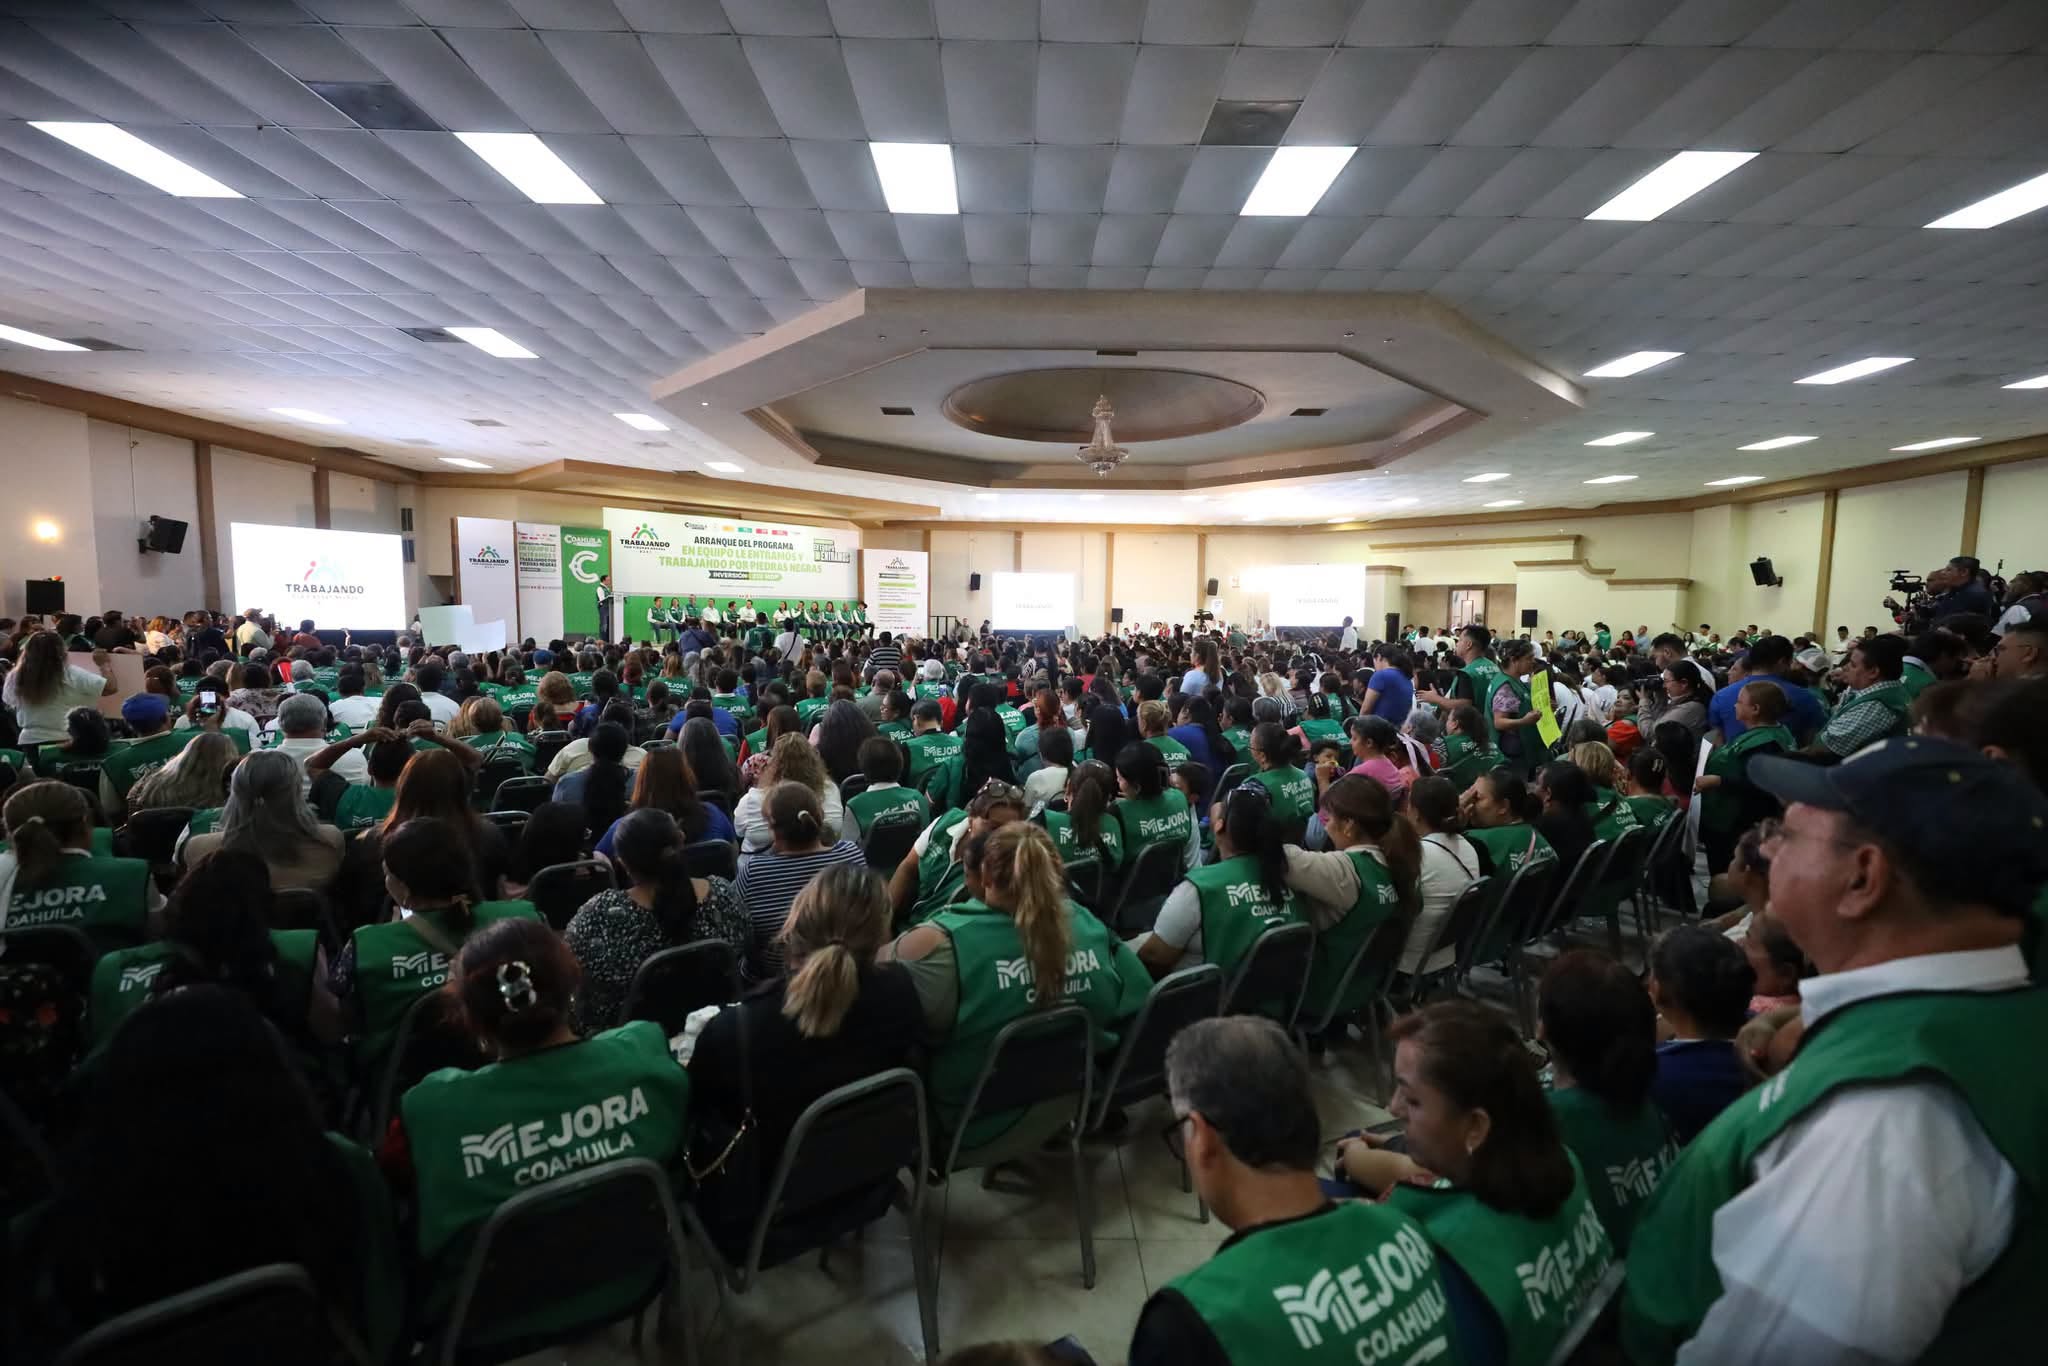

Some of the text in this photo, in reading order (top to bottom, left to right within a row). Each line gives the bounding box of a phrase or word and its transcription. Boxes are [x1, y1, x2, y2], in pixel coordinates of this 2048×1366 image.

[620, 539, 670, 548] TRABAJANDO
[682, 545, 695, 556] EN
[698, 547, 733, 559] EQUIPO
[735, 549, 747, 559] LE
[748, 550, 796, 561] ENTRAMOS
[693, 536, 794, 551] ARRANQUE DEL PROGRAMA
[659, 556, 822, 573] TRABAJANDO POR PIEDRAS NEGRAS
[285, 583, 364, 594] TRABAJANDO
[1163, 752, 1188, 761] EJORA
[1139, 809, 1190, 837] MEJORA
[9, 884, 107, 911] EJORA
[7, 906, 84, 928] OAHUILA
[996, 949, 1101, 990] MORA
[1026, 977, 1092, 1003] CUILA
[460, 1086, 649, 1178] MEJORA
[514, 1131, 634, 1185] COAHUILA
[1272, 1222, 1434, 1349] MEJORA
[1355, 1279, 1447, 1366] COAHUIL
